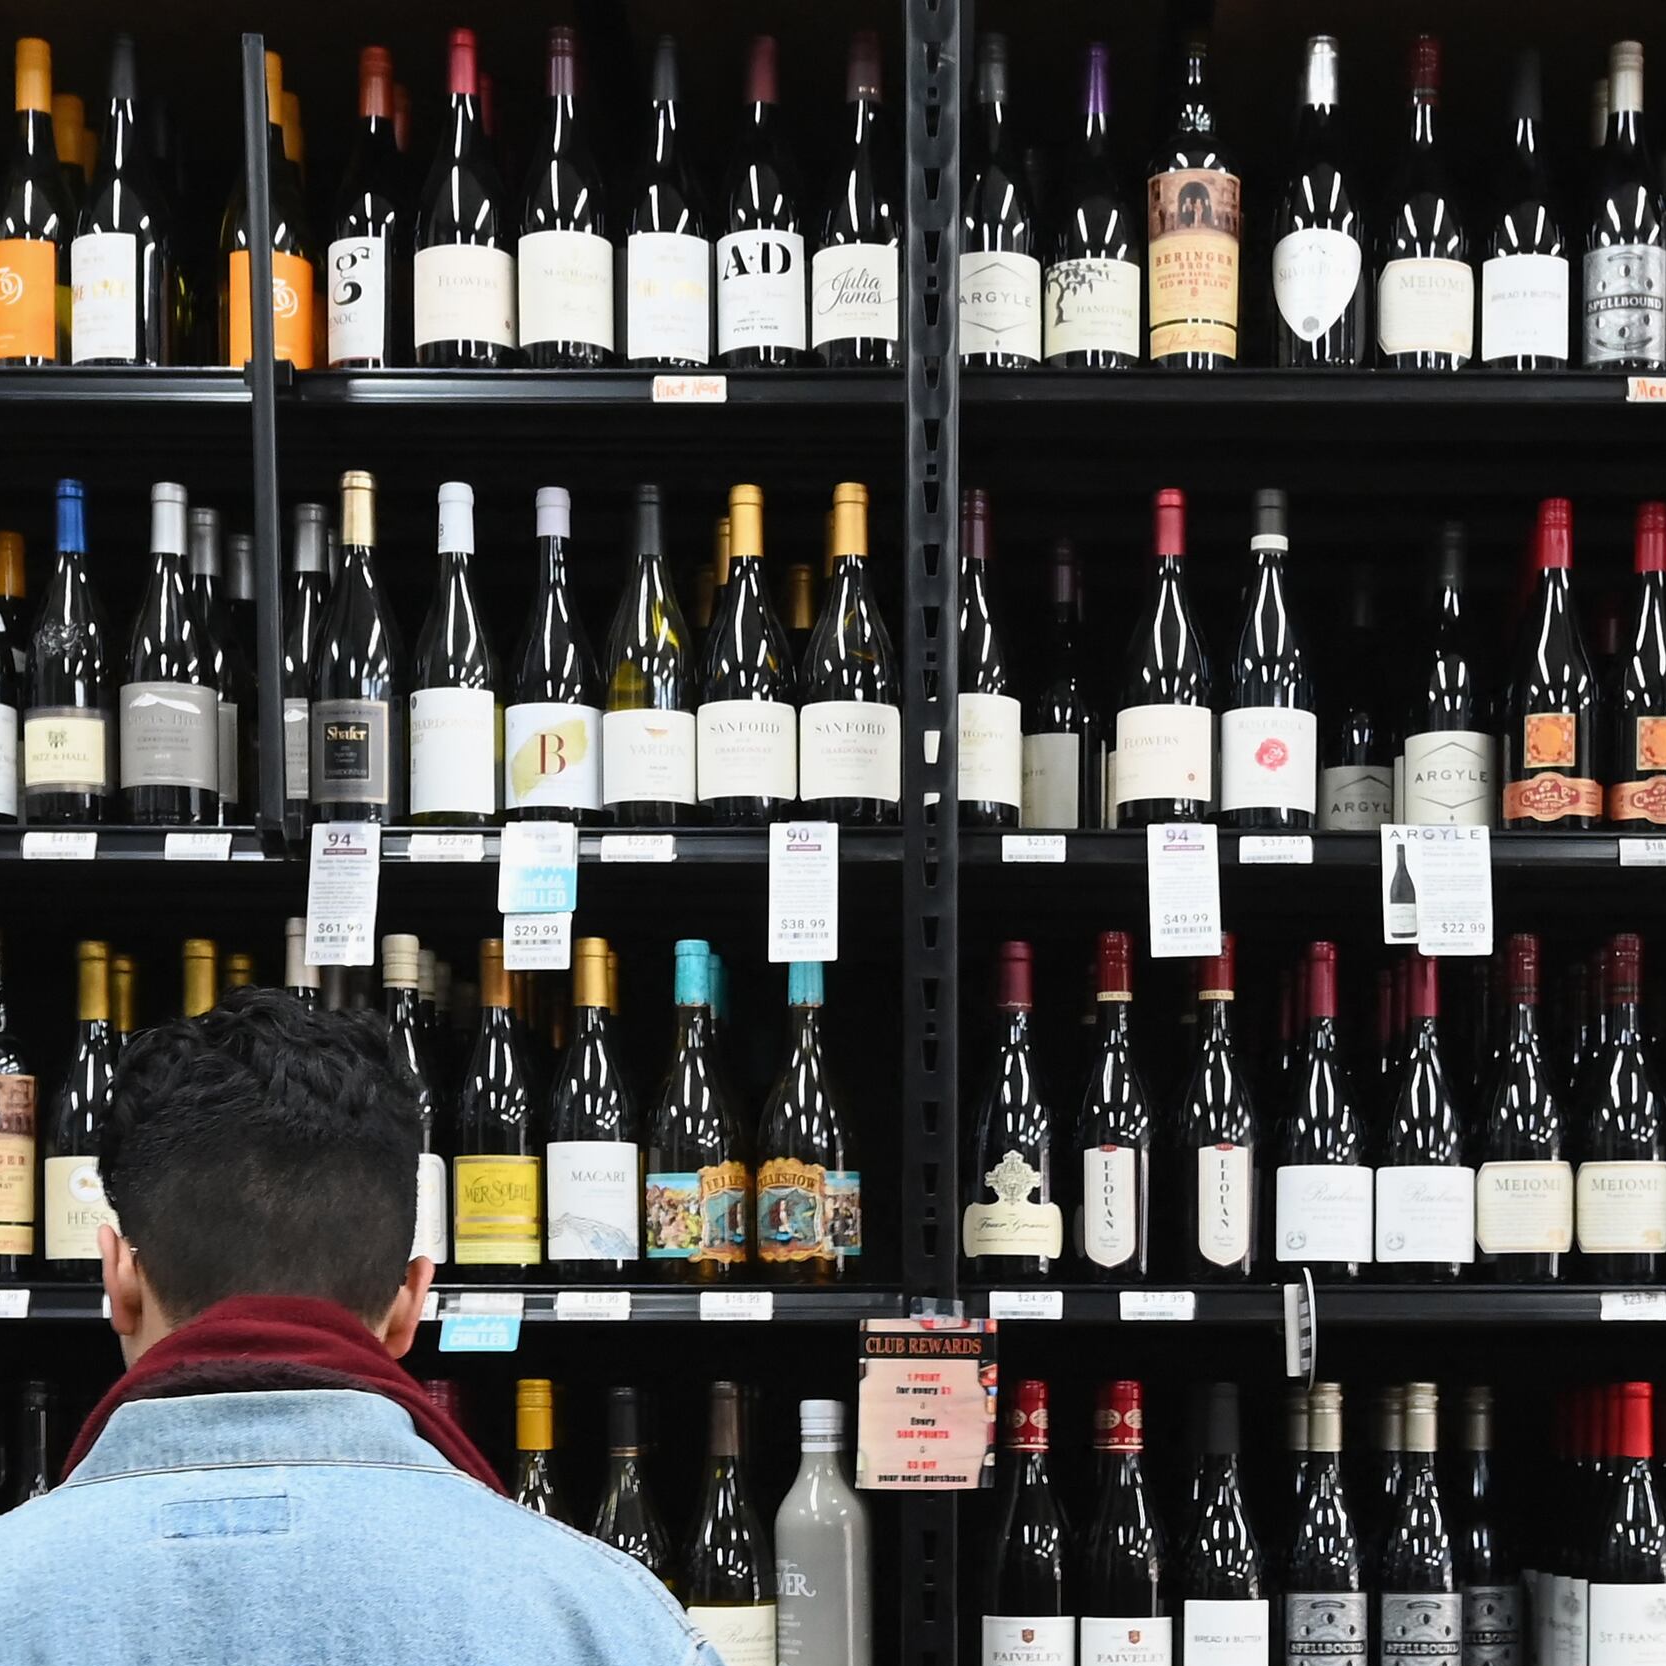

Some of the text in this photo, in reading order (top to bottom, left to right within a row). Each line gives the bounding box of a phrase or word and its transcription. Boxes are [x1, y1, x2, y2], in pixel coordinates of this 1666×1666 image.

[1155, 251, 1233, 268] BERINGER
[830, 267, 881, 292] Julia
[1399, 274, 1465, 292] MEIOMI
[958, 292, 1032, 308] ARGYLE
[1587, 297, 1662, 311] SPELLBOUND
[655, 378, 686, 398] Pinot
[326, 724, 366, 743] Shafer
[709, 721, 780, 735] SANFORD
[814, 721, 885, 735] SANFORD
[1123, 735, 1179, 749] FLOWERS
[535, 733, 566, 775] B
[1415, 769, 1488, 785] ARGYLE
[327, 832, 352, 847] 94
[786, 829, 810, 844] 90
[1166, 828, 1190, 844] 94
[1389, 829, 1481, 840] ARGYLE
[780, 918, 826, 930] $38.99
[1162, 912, 1209, 925] $49.99
[317, 923, 363, 936] $61.99
[514, 925, 559, 937] $29.99
[1440, 922, 1486, 935] $22.99
[571, 1170, 626, 1183] MACARI
[1494, 1178, 1561, 1192] MEIOMI
[1590, 1177, 1658, 1192] MEIOMI
[1102, 1159, 1116, 1232] ELOUAN
[1218, 1157, 1231, 1231] ELOUAN
[66, 1212, 109, 1227] HESS
[866, 1337, 982, 1354] CLUB REWARDS
[1290, 1641, 1364, 1655] SPELLBOUND
[1383, 1641, 1459, 1655] SPELLBOUND
[993, 1652, 1064, 1664] FAIVELEY
